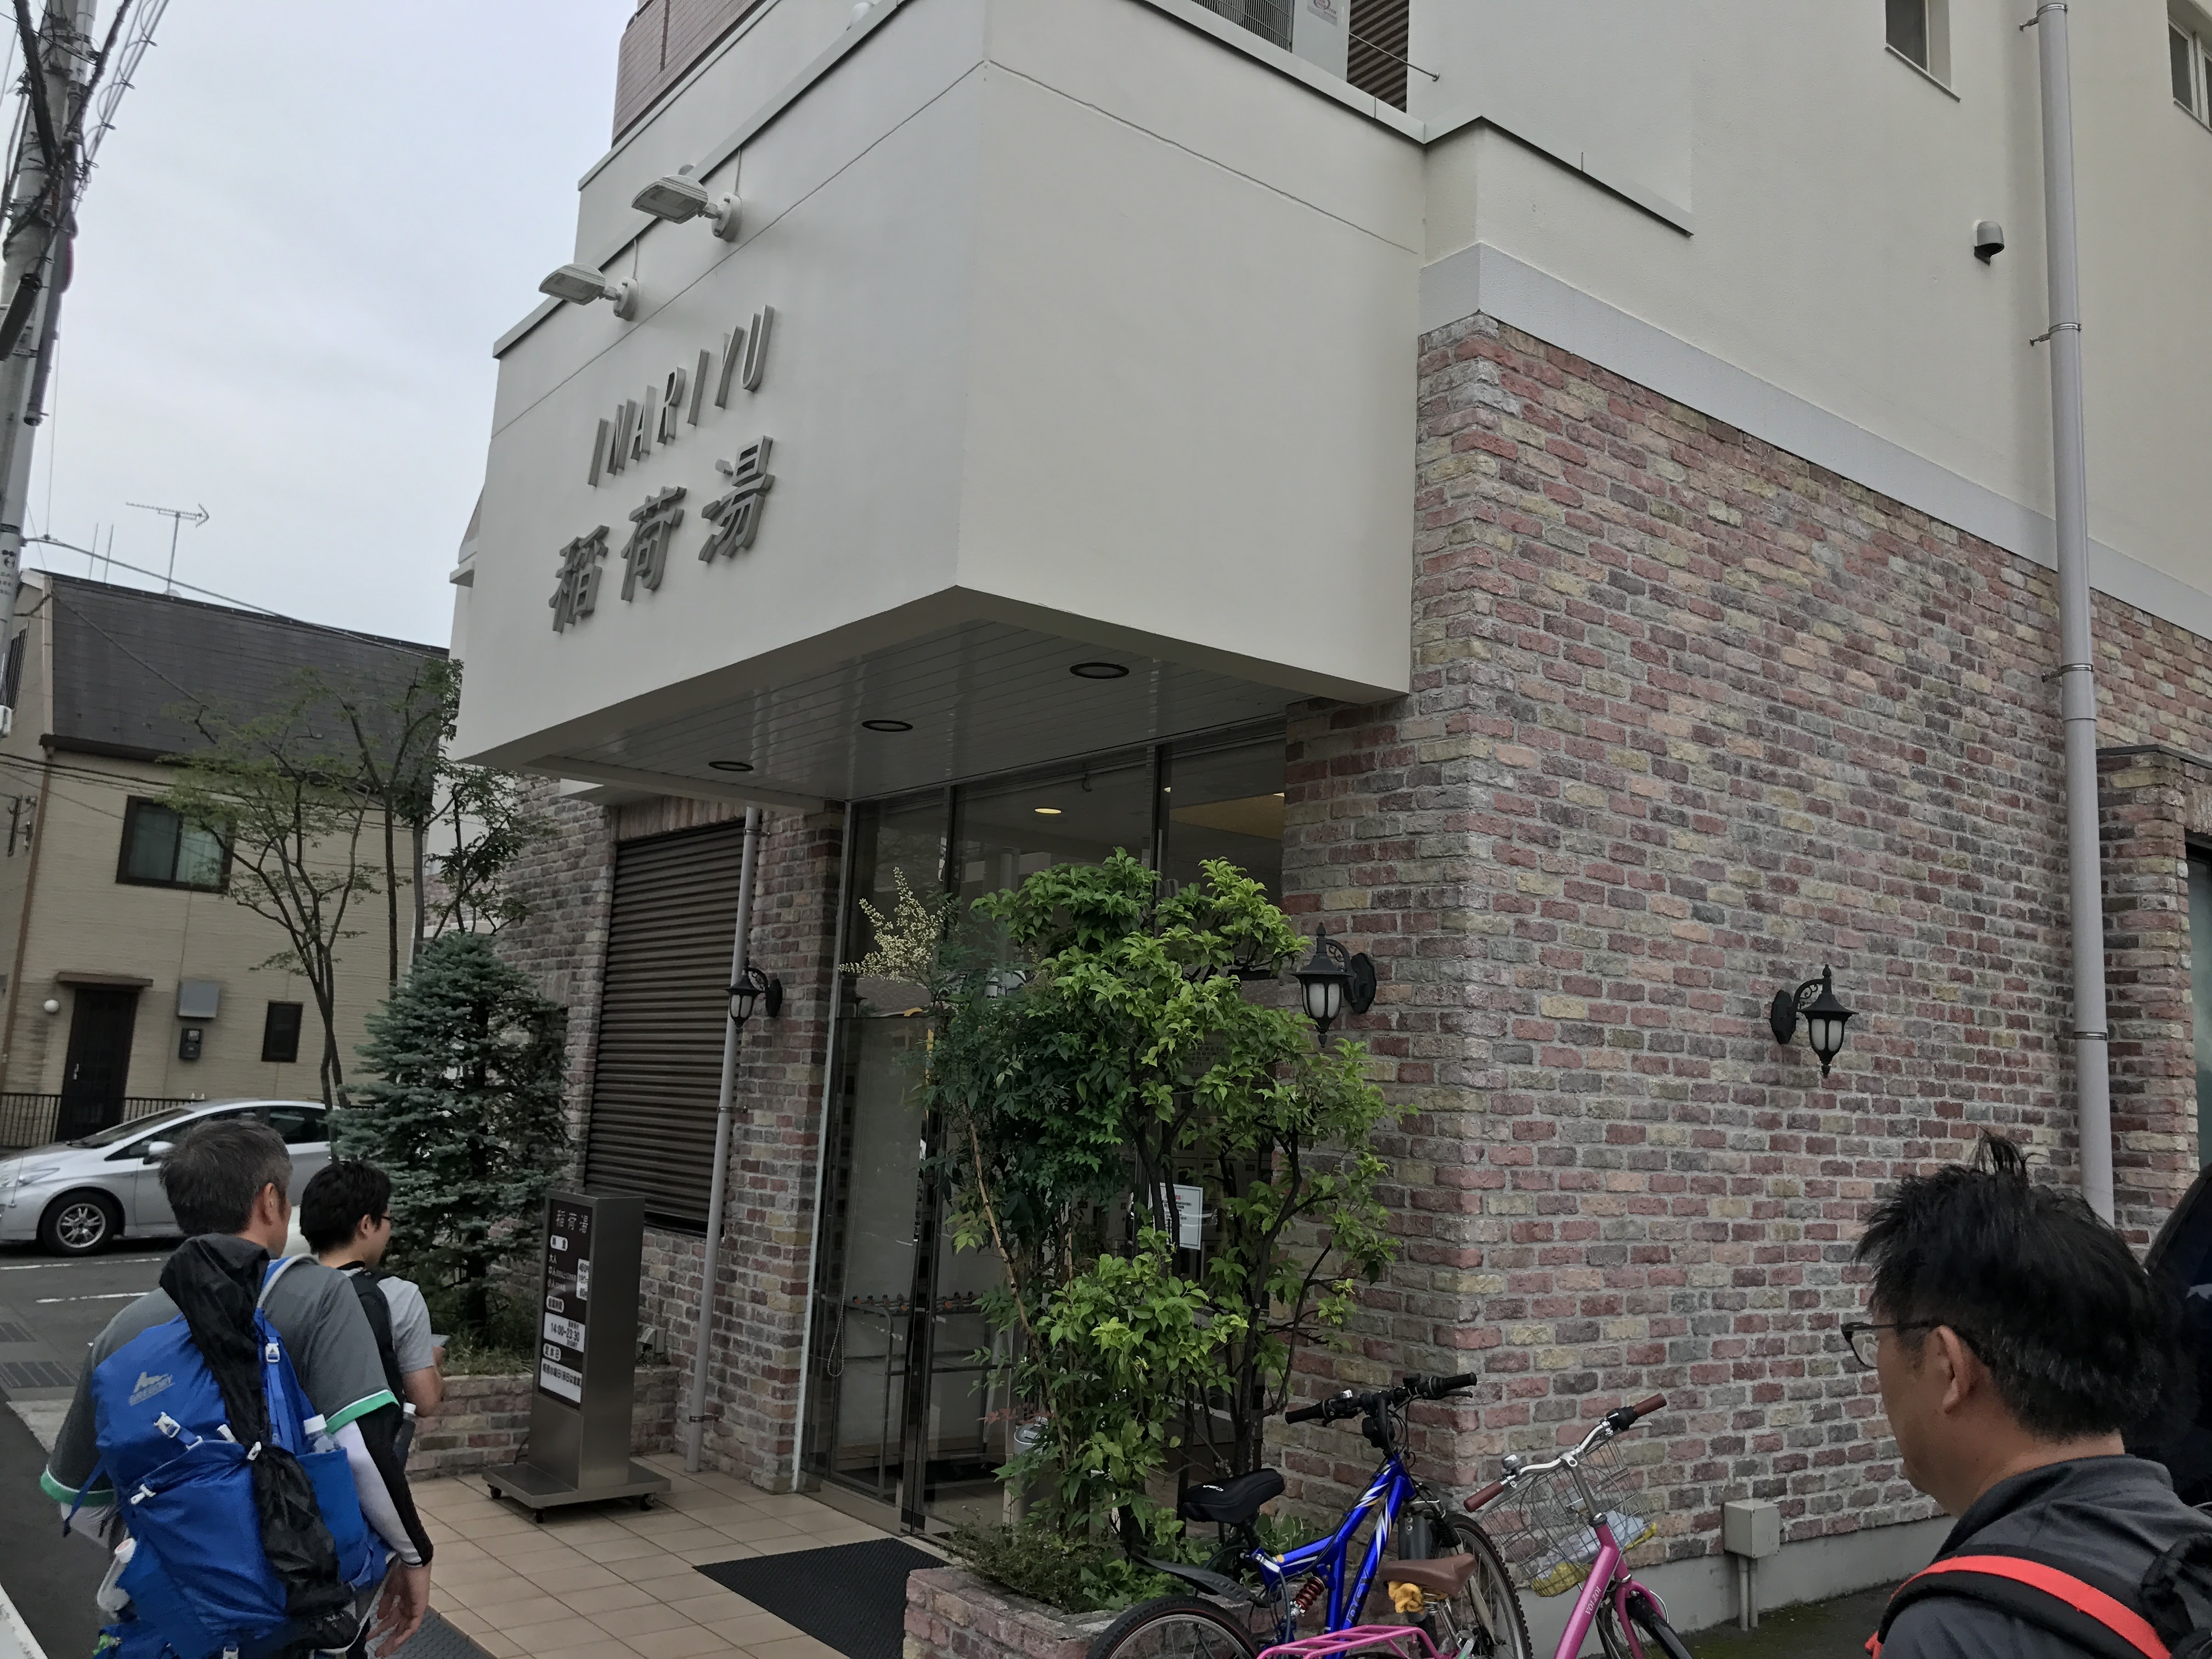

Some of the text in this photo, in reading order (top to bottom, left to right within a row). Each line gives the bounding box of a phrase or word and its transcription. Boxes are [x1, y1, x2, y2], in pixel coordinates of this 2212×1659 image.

[587, 304, 775, 488] INARIYU
[549, 435, 776, 633] 稲荷湯
